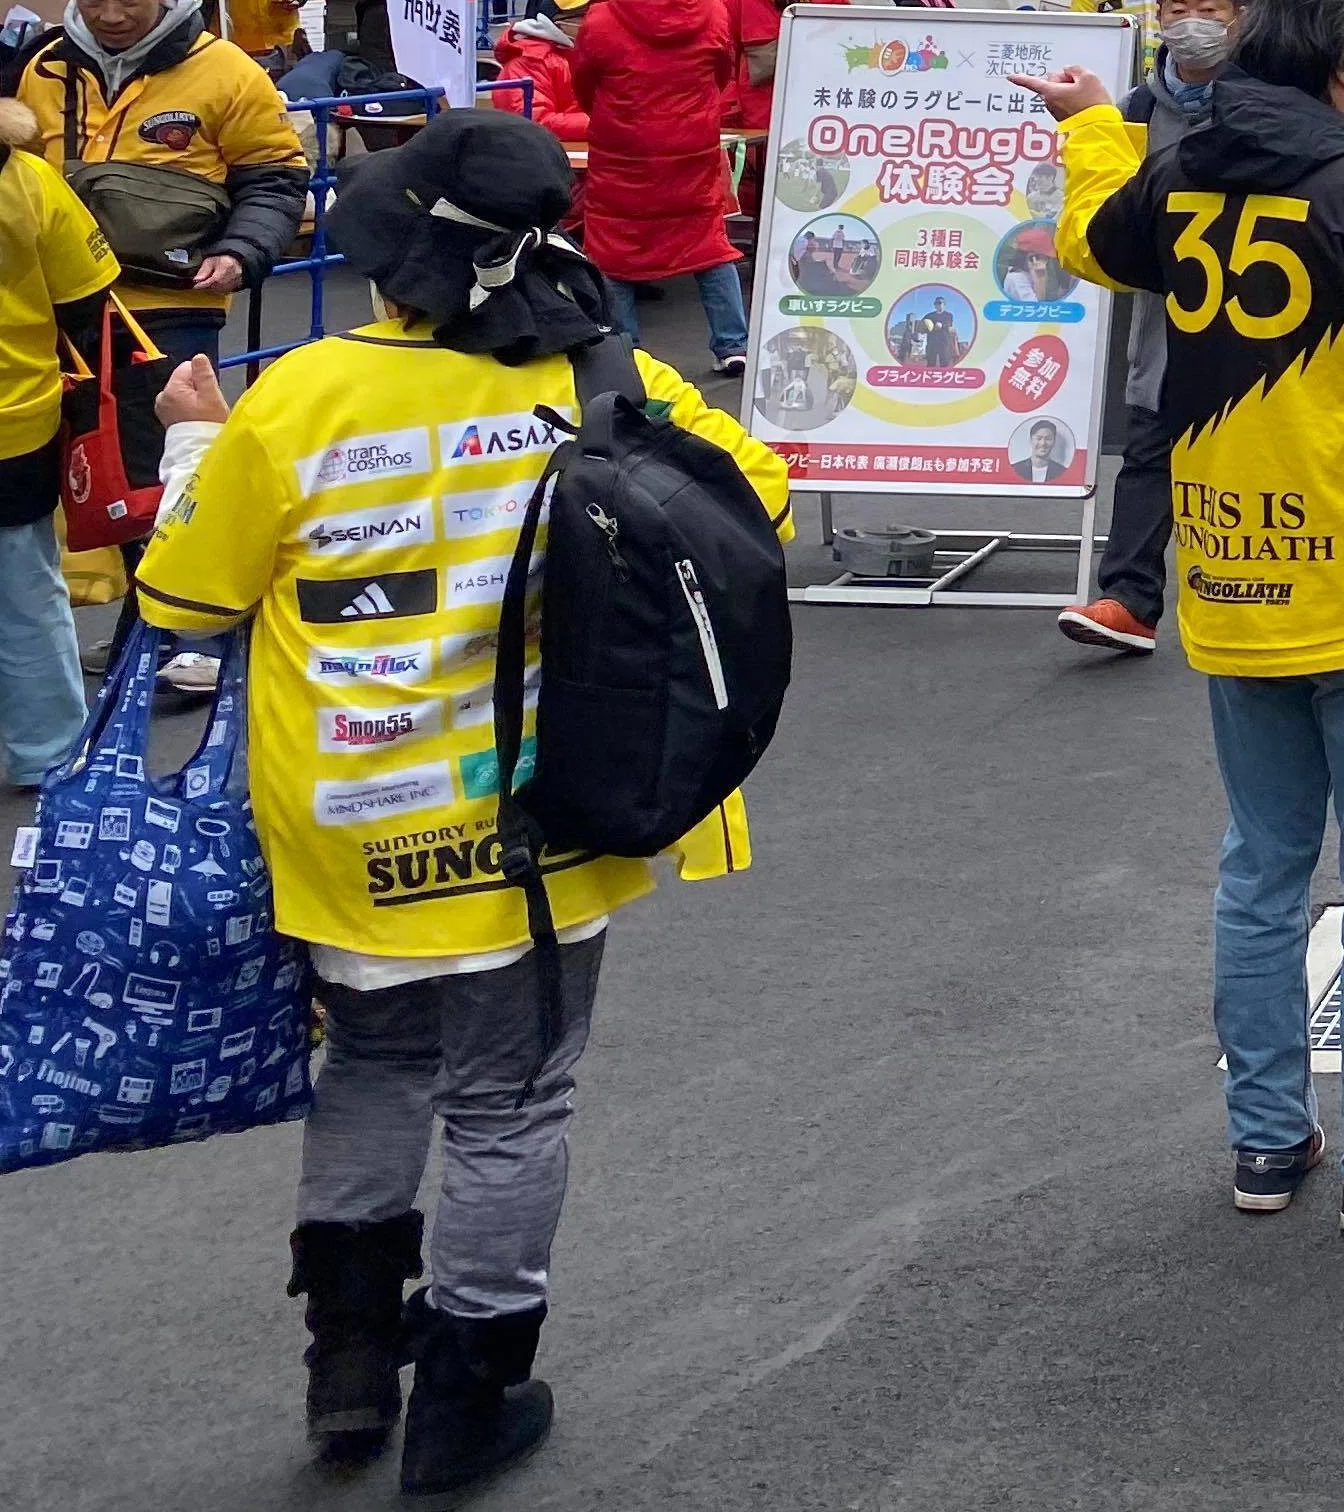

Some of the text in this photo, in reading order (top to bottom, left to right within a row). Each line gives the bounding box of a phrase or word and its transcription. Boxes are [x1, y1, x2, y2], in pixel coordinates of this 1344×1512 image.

[987, 43, 1054, 61] 三菱地所と
[807, 116, 919, 162] One
[875, 162, 1015, 207] 体験会
[917, 229, 963, 248] 3種目
[894, 249, 980, 270] 同時体験会
[1165, 191, 1312, 340] 35
[787, 298, 874, 314] 車いすラグビー
[999, 304, 1073, 318] デフラグビー
[1021, 347, 1062, 380] 参加
[876, 369, 977, 385] ブラインドラグビー
[1007, 366, 1049, 401] 無料
[486, 422, 558, 455] ASAX
[347, 443, 388, 461] trans
[347, 451, 413, 473] cosmos
[452, 499, 517, 523] TOKYO
[1258, 491, 1306, 530] IS
[331, 514, 421, 542] SEINAN
[454, 574, 505, 593] KASH
[362, 824, 466, 854] SUNTORY
